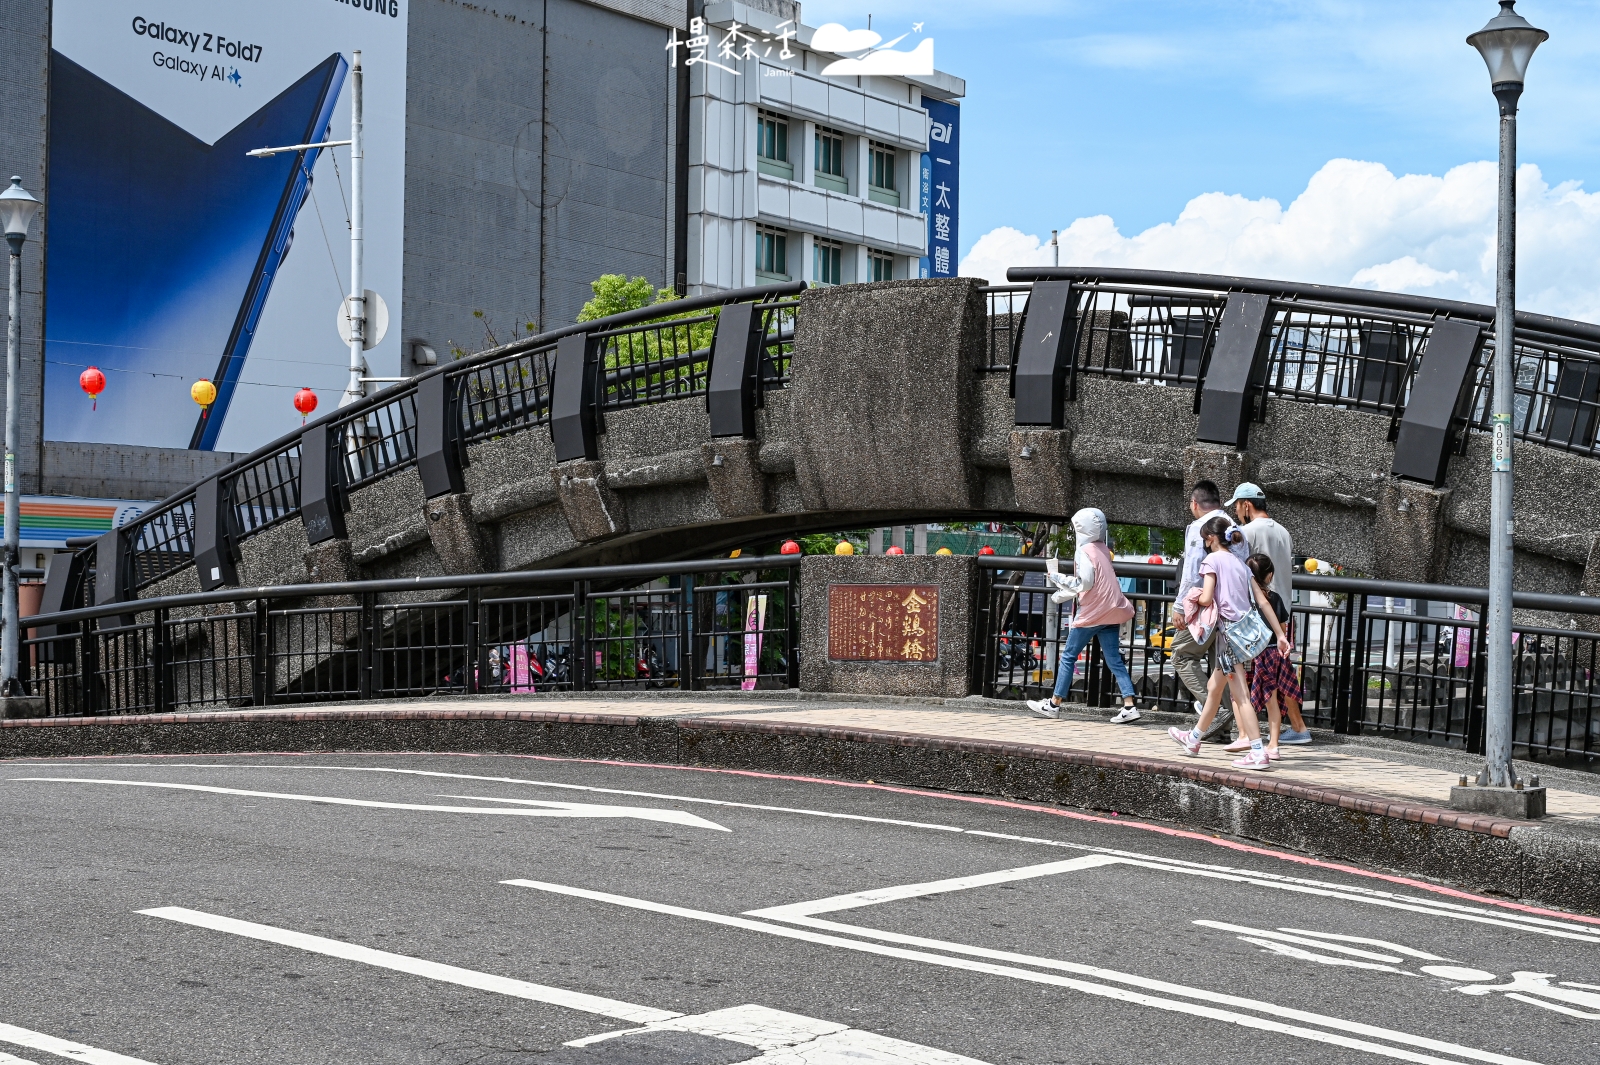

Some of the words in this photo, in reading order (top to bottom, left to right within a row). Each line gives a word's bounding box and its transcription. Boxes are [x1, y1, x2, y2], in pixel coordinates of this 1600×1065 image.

[132, 16, 200, 52] Galaxy
[203, 33, 213, 52] Z
[217, 36, 263, 63] Fold7
[152, 51, 208, 81] Galaxy
[211, 65, 225, 81] AI
[935, 157, 951, 274] 一太整體
